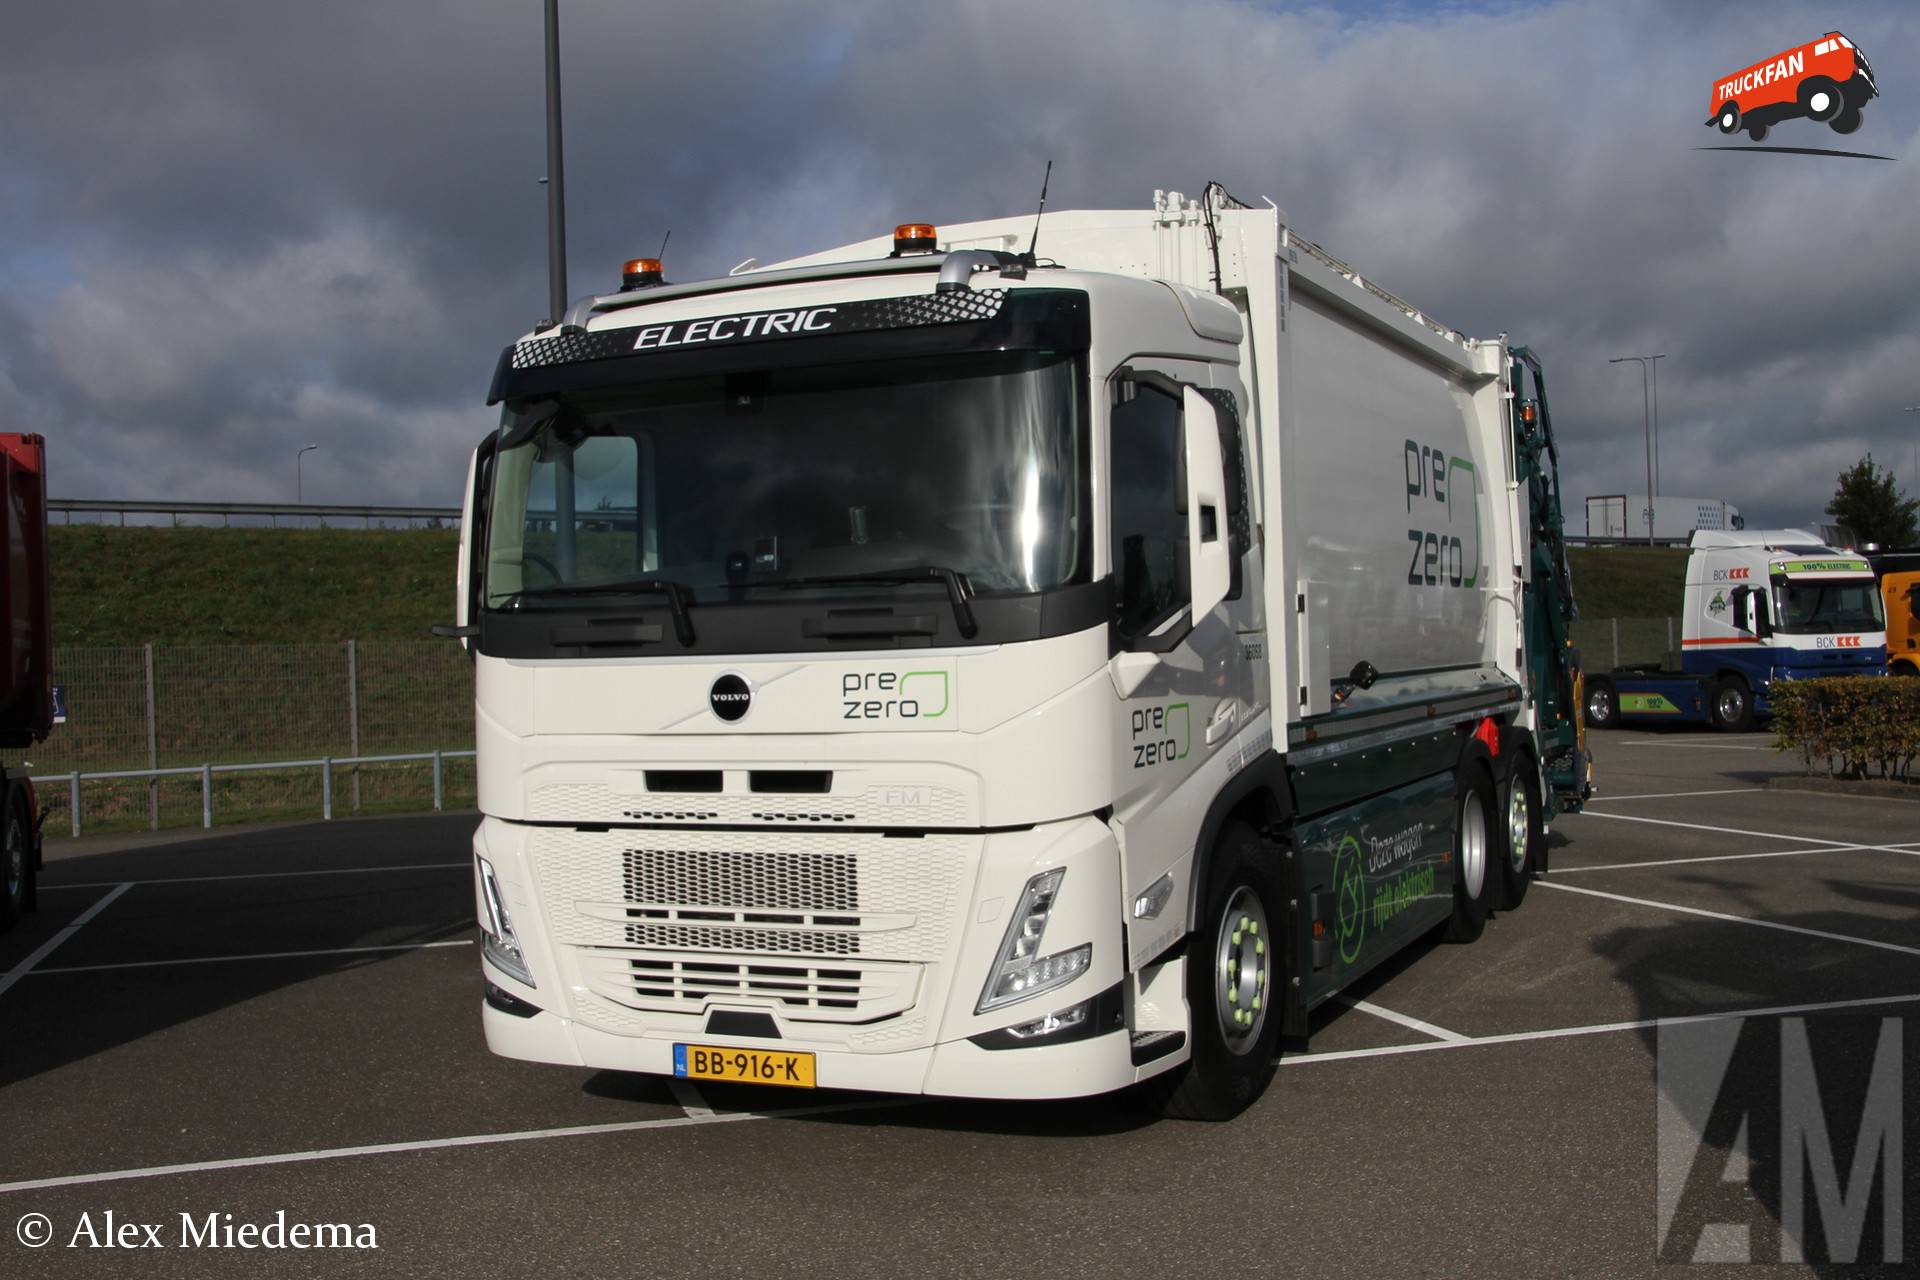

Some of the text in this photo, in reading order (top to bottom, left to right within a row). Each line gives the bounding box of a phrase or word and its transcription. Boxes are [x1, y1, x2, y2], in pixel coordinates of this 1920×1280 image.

[633, 308, 837, 350] ELECTRIC
[1405, 439, 1446, 515] pre
[1408, 529, 1462, 588] zero
[1713, 569, 1728, 581] BCK
[1816, 637, 1835, 648] BCK
[712, 693, 749, 702] VOLVO
[843, 672, 897, 697] pre
[843, 698, 919, 720] zero
[1132, 706, 1164, 740] pre
[1133, 739, 1176, 769] zero
[886, 790, 921, 804] FM
[1394, 822, 1424, 861] wagen
[676, 1050, 800, 1081] NL BB-916-K
